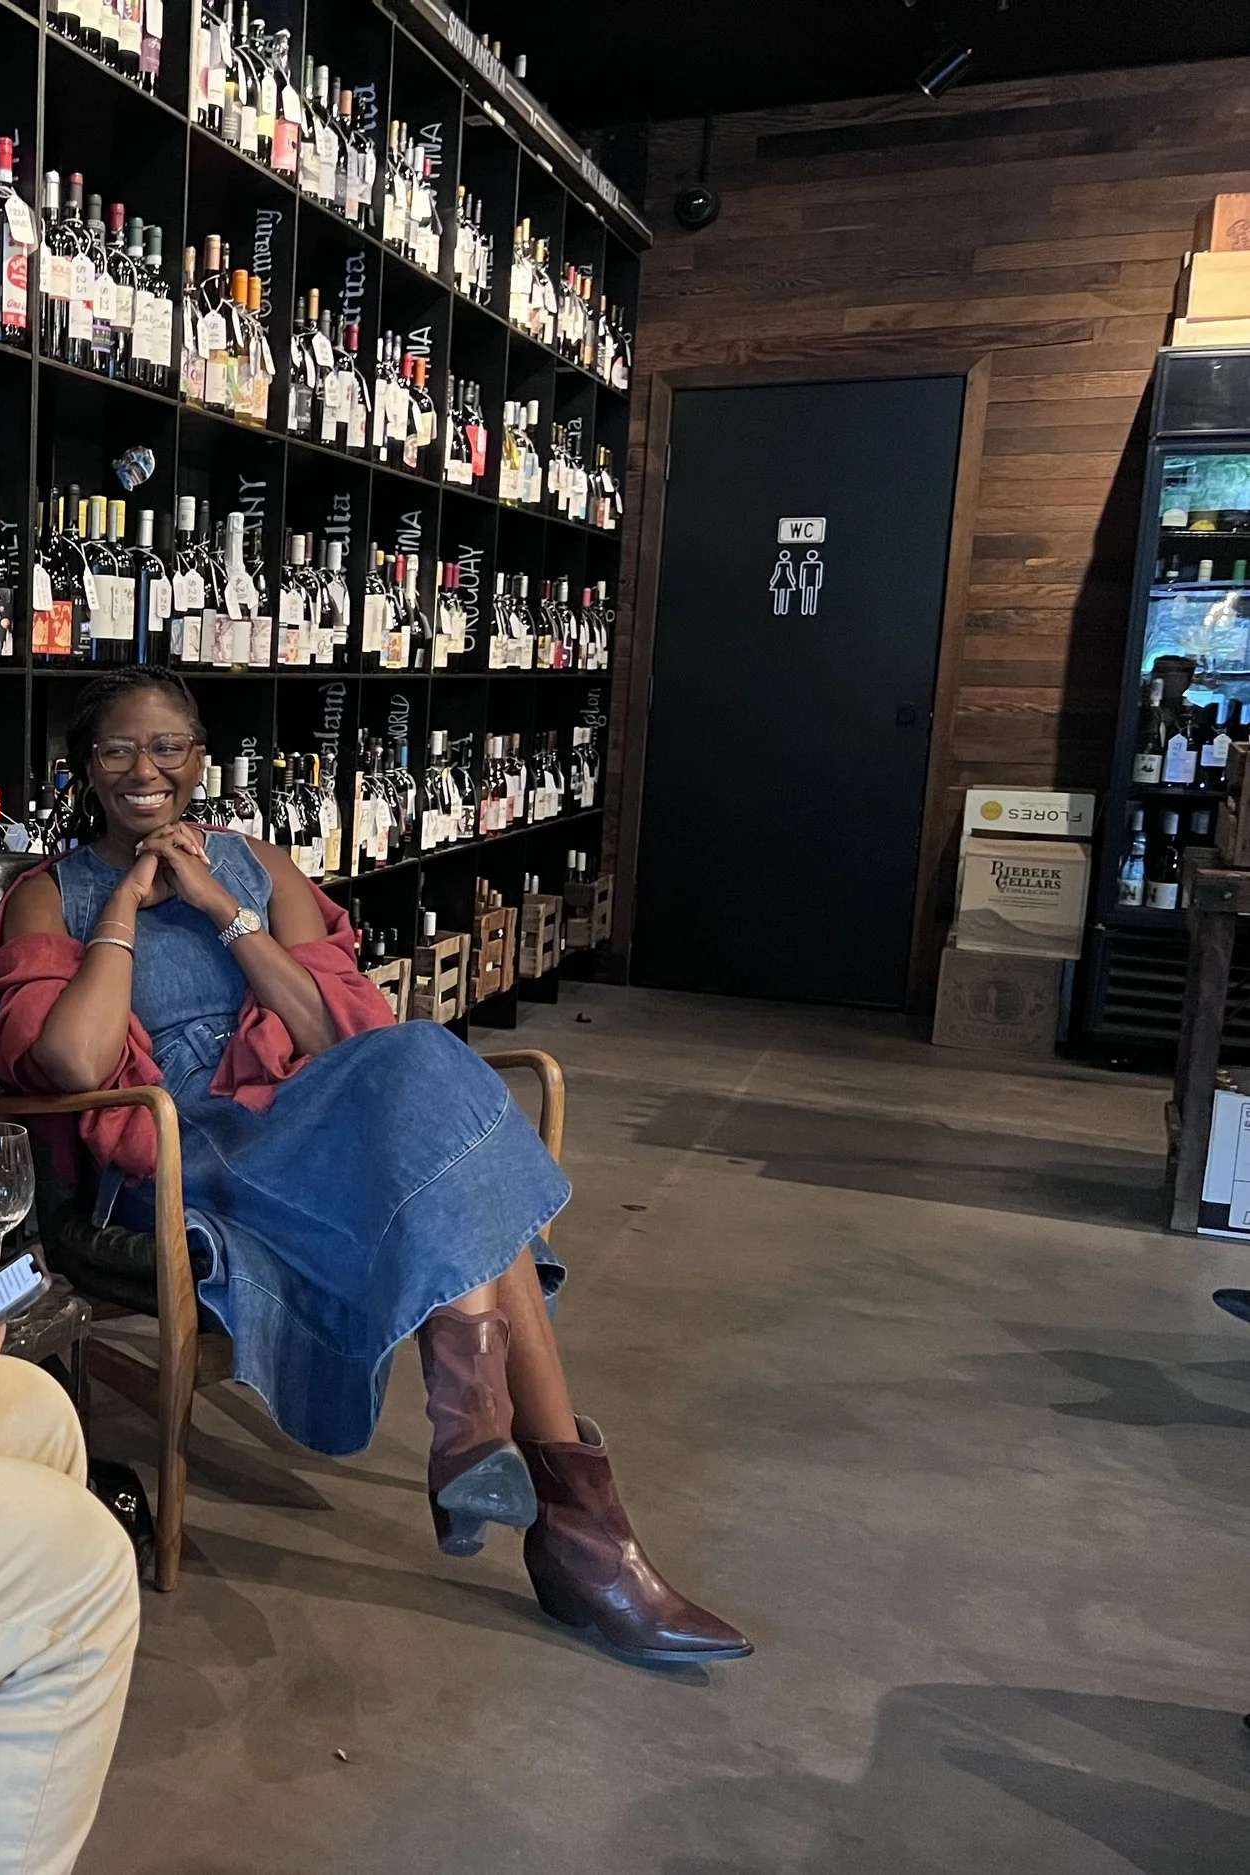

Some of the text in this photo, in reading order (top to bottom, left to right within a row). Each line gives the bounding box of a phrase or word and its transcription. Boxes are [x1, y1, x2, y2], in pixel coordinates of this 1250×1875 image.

[447, 11, 506, 94] SOUTH AMERICA
[790, 522, 814, 539] WC
[1008, 808, 1083, 823] FLORES
